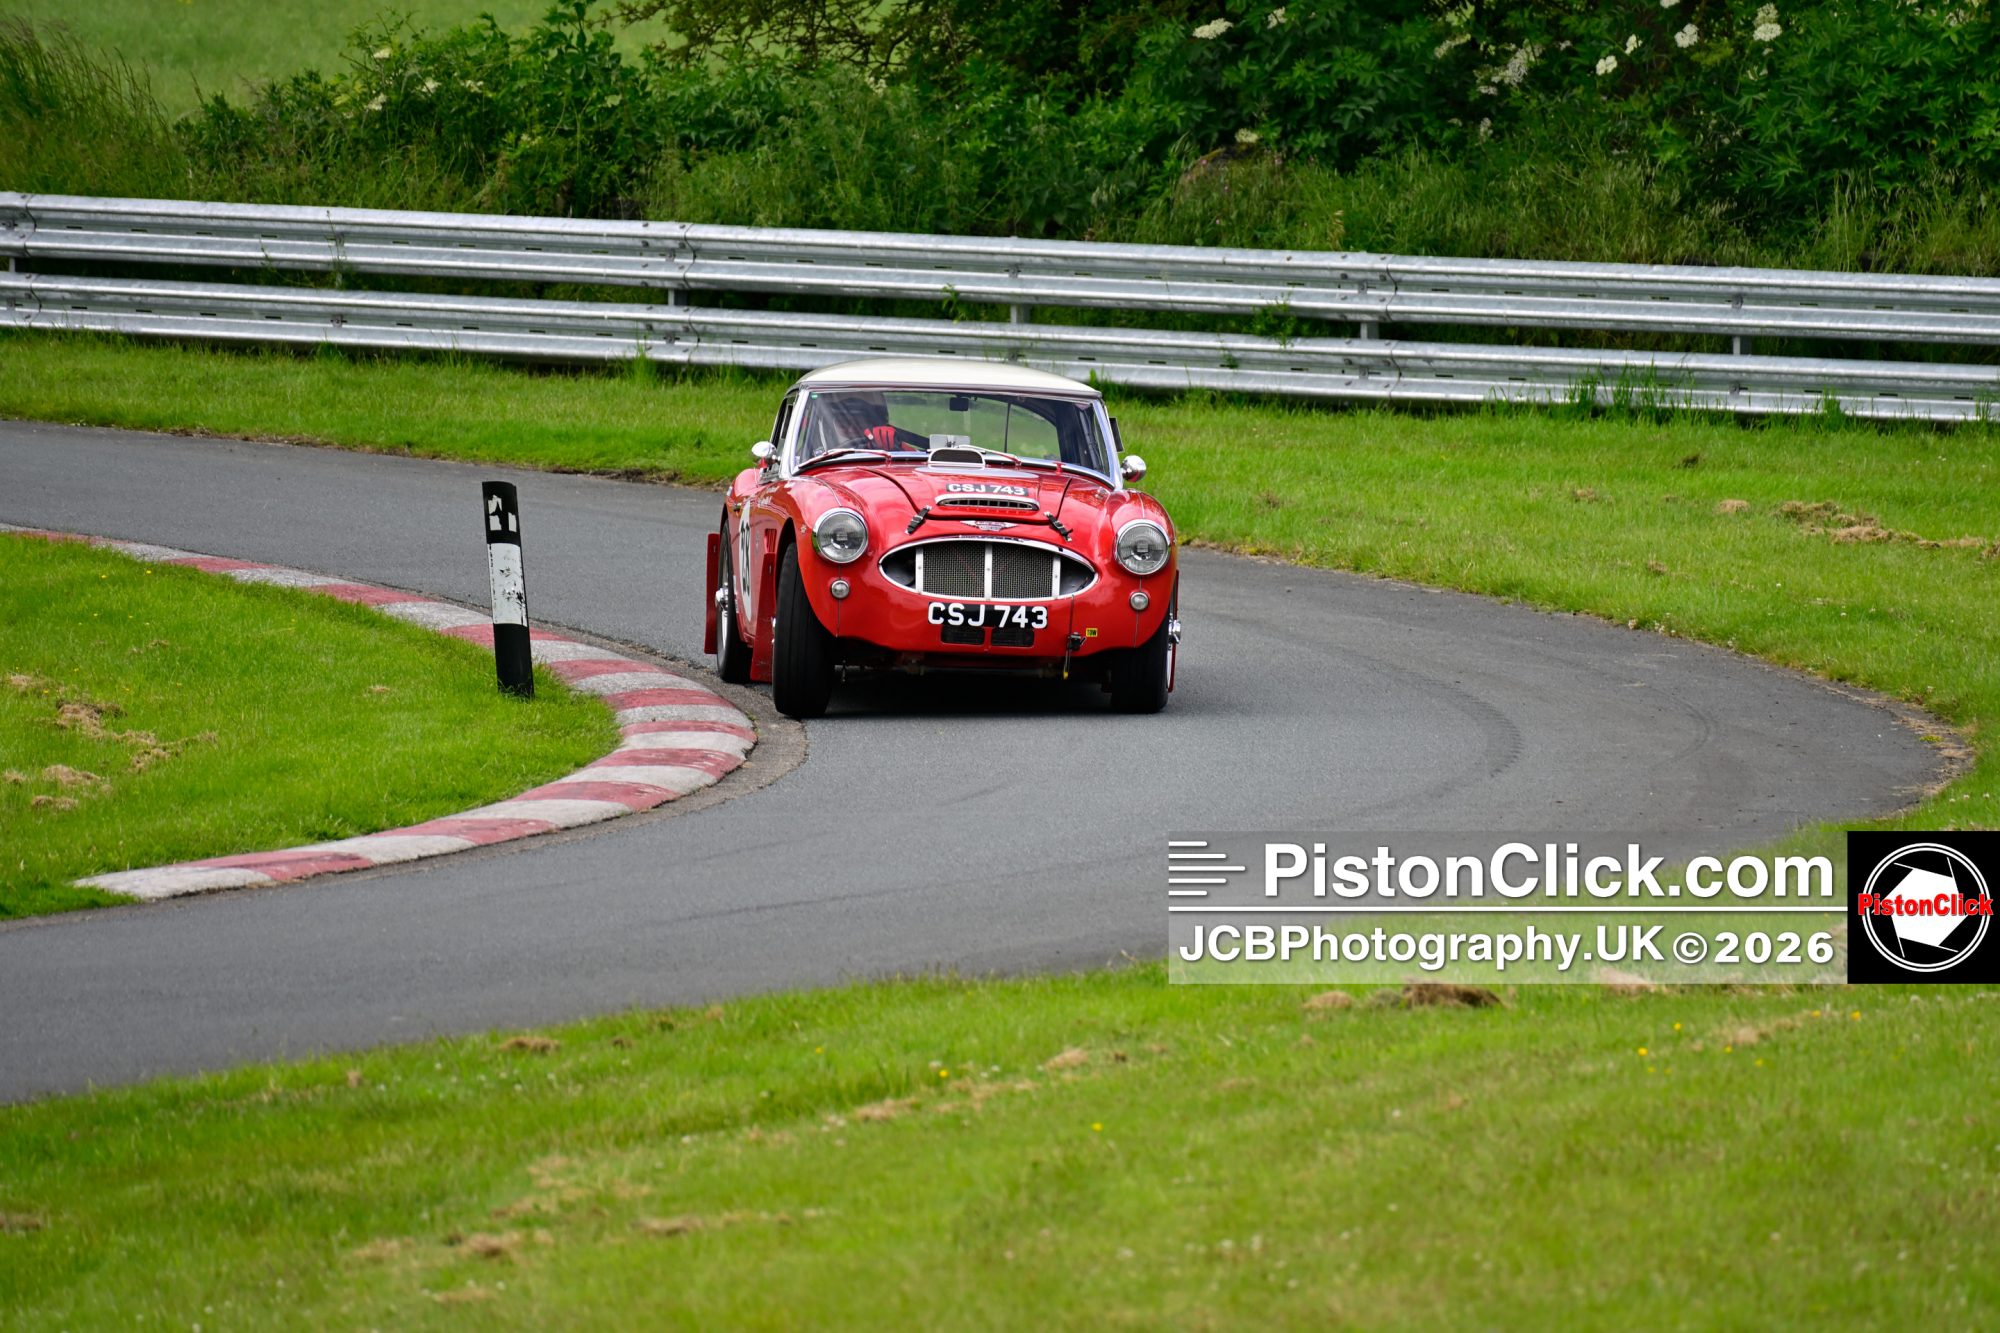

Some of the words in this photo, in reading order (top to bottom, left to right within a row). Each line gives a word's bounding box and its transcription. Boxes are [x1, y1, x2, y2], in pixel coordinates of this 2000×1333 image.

[948, 483, 986, 493] CSJ
[990, 485, 1025, 496] 743
[928, 602, 986, 627] CSJ
[994, 604, 1048, 629] 743
